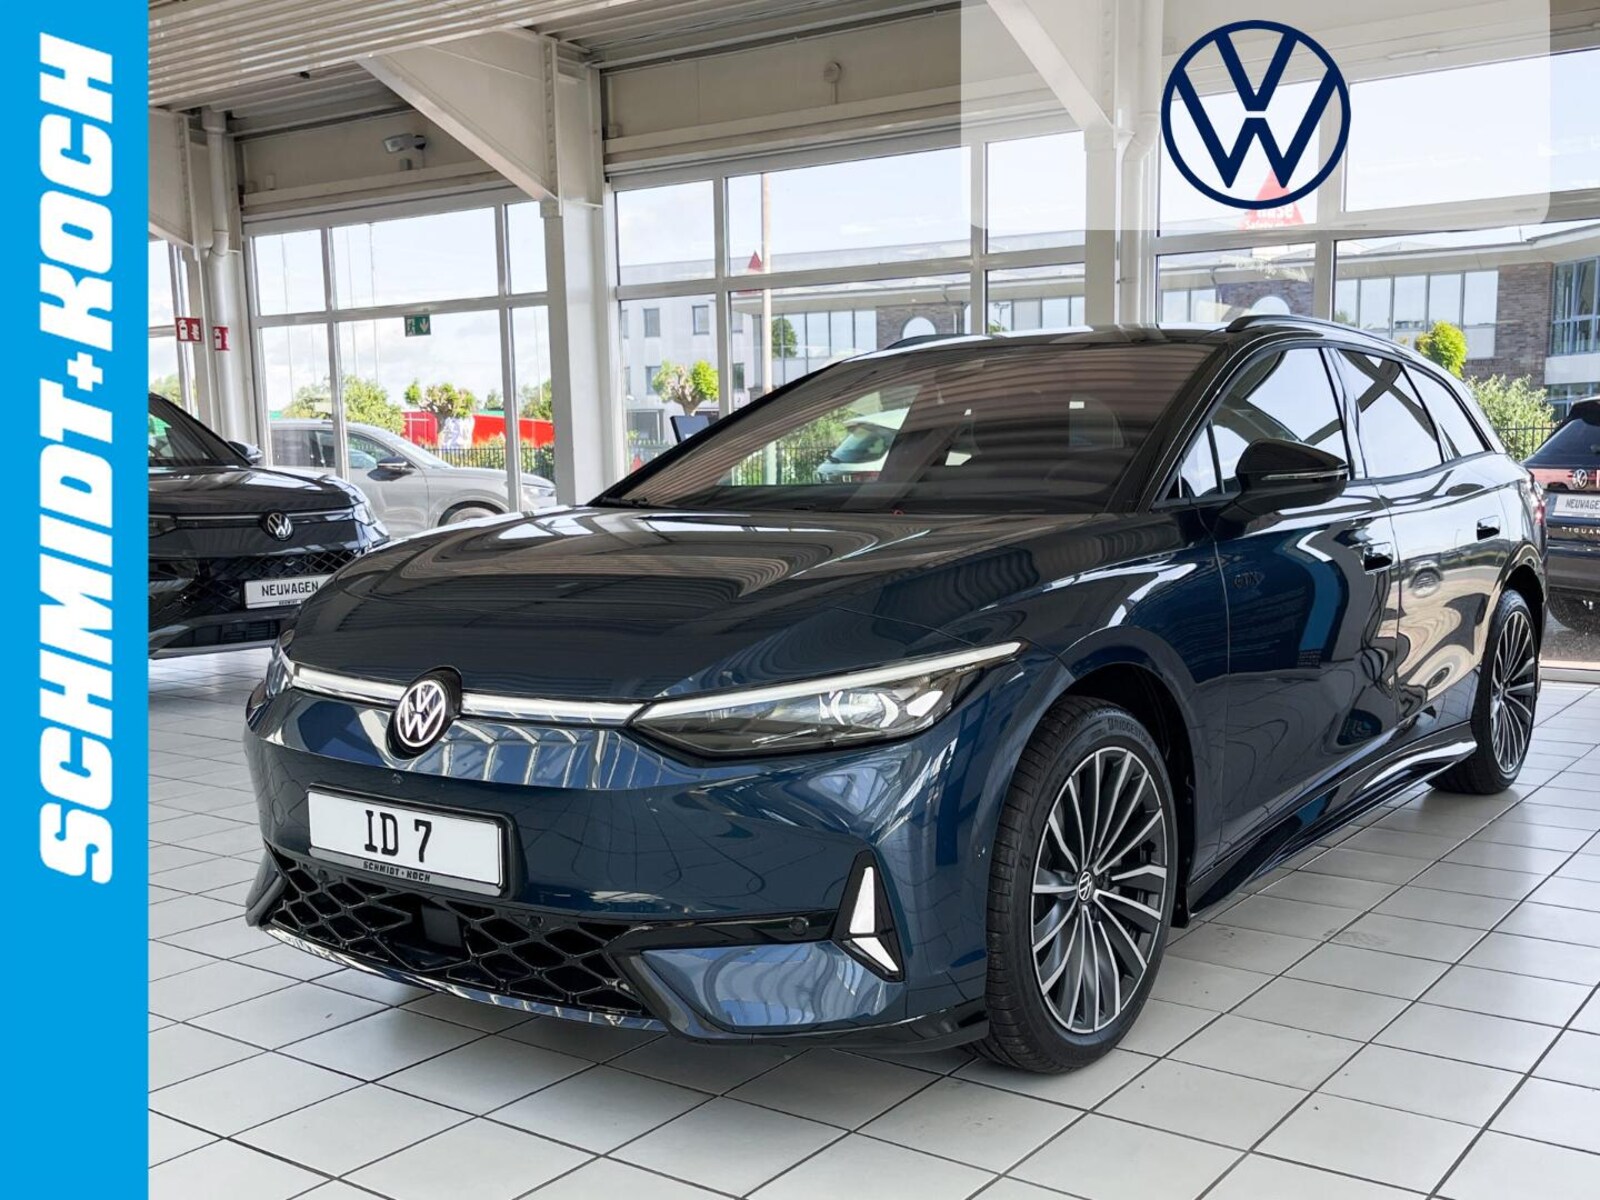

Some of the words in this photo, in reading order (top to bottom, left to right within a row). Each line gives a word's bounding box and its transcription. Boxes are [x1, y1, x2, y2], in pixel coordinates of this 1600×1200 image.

[261, 581, 319, 597] NEUWAGEN
[397, 680, 446, 748] VW
[364, 809, 399, 857] ID
[414, 818, 432, 863] 7
[363, 860, 400, 876] SCHMIDT
[406, 869, 431, 882] KOCH
